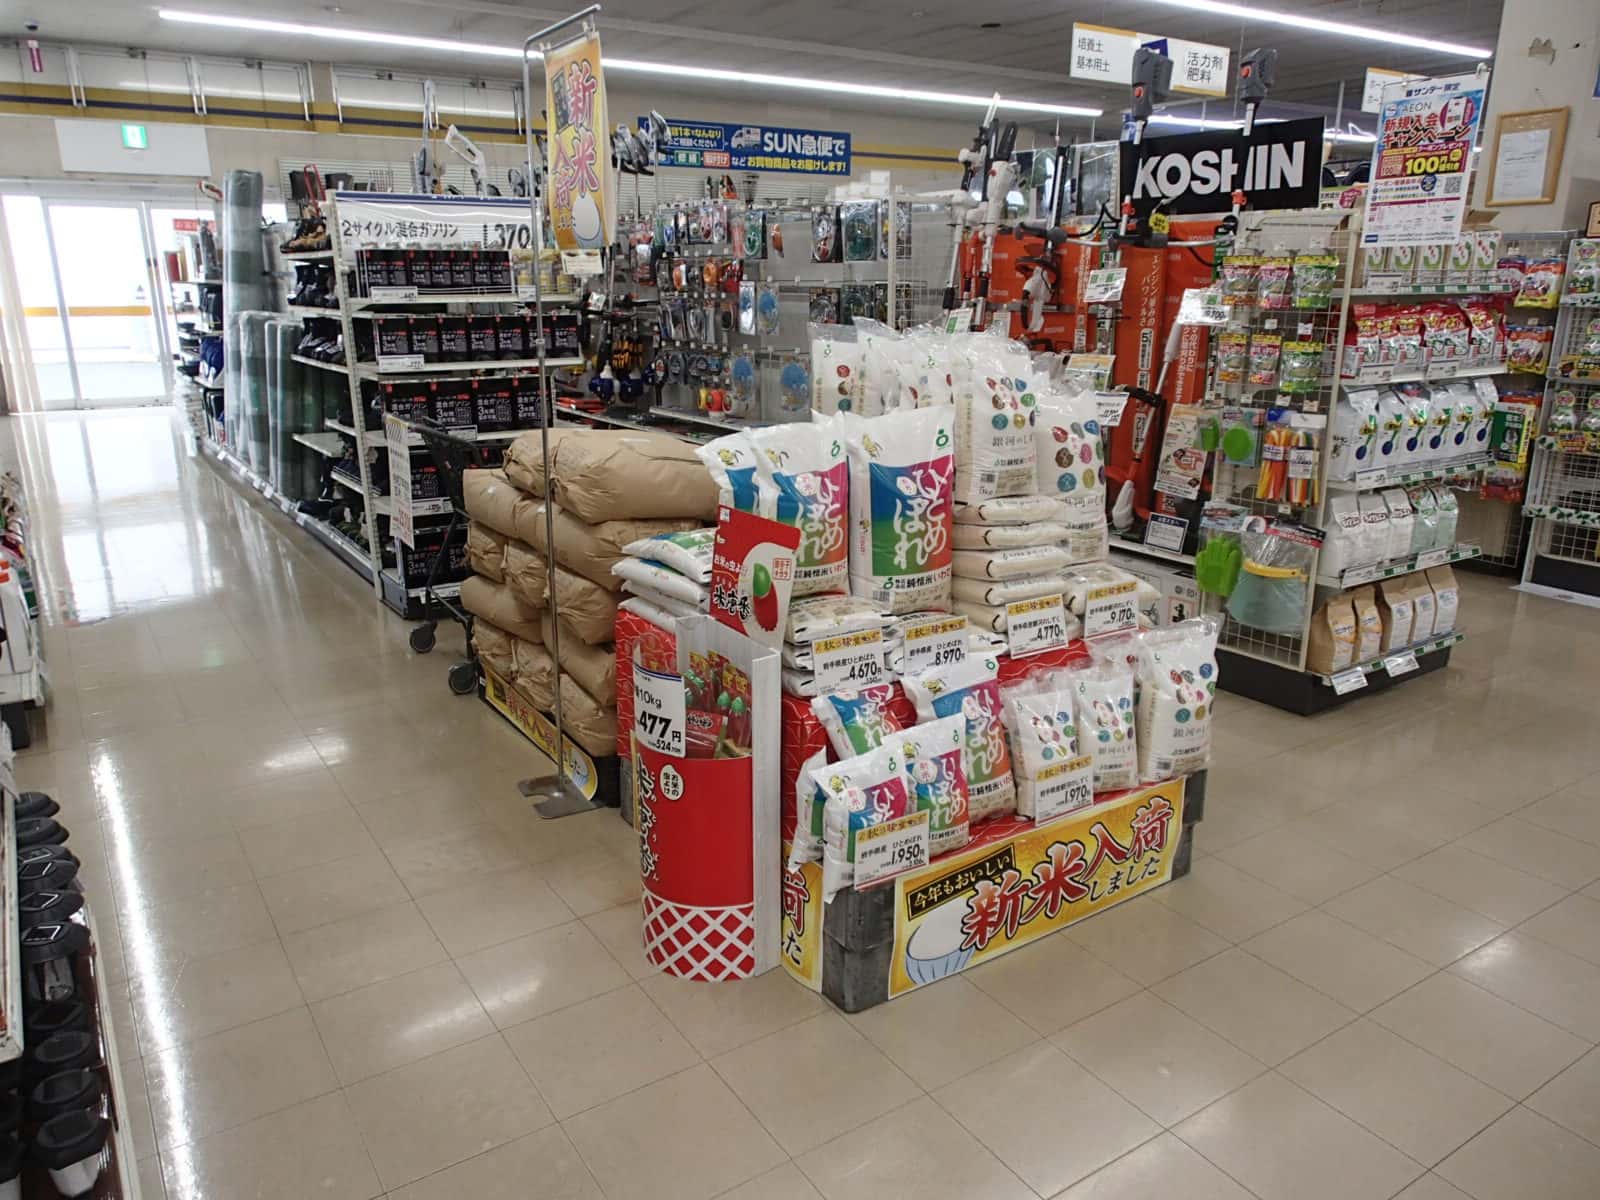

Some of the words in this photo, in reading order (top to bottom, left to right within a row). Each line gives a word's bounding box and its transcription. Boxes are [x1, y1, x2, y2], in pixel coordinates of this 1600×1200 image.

[1077, 37, 1104, 53] 培養土
[1076, 56, 1110, 73] 基本用土
[1187, 51, 1223, 71] 活力剤
[1186, 67, 1212, 84] 肥料
[1402, 102, 1432, 113] AEON
[567, 58, 600, 193] 新米
[1384, 112, 1438, 132] 新規入会
[763, 132, 846, 157] SUN急便で
[1383, 126, 1471, 149] キャンペーン
[1132, 141, 1305, 200] KOSHIN
[342, 219, 459, 238] 2サイクル混合ガソリン
[914, 855, 1010, 908] 今年もおいしい
[959, 796, 1175, 952] 新米入荷
[1089, 856, 1160, 902] しました
